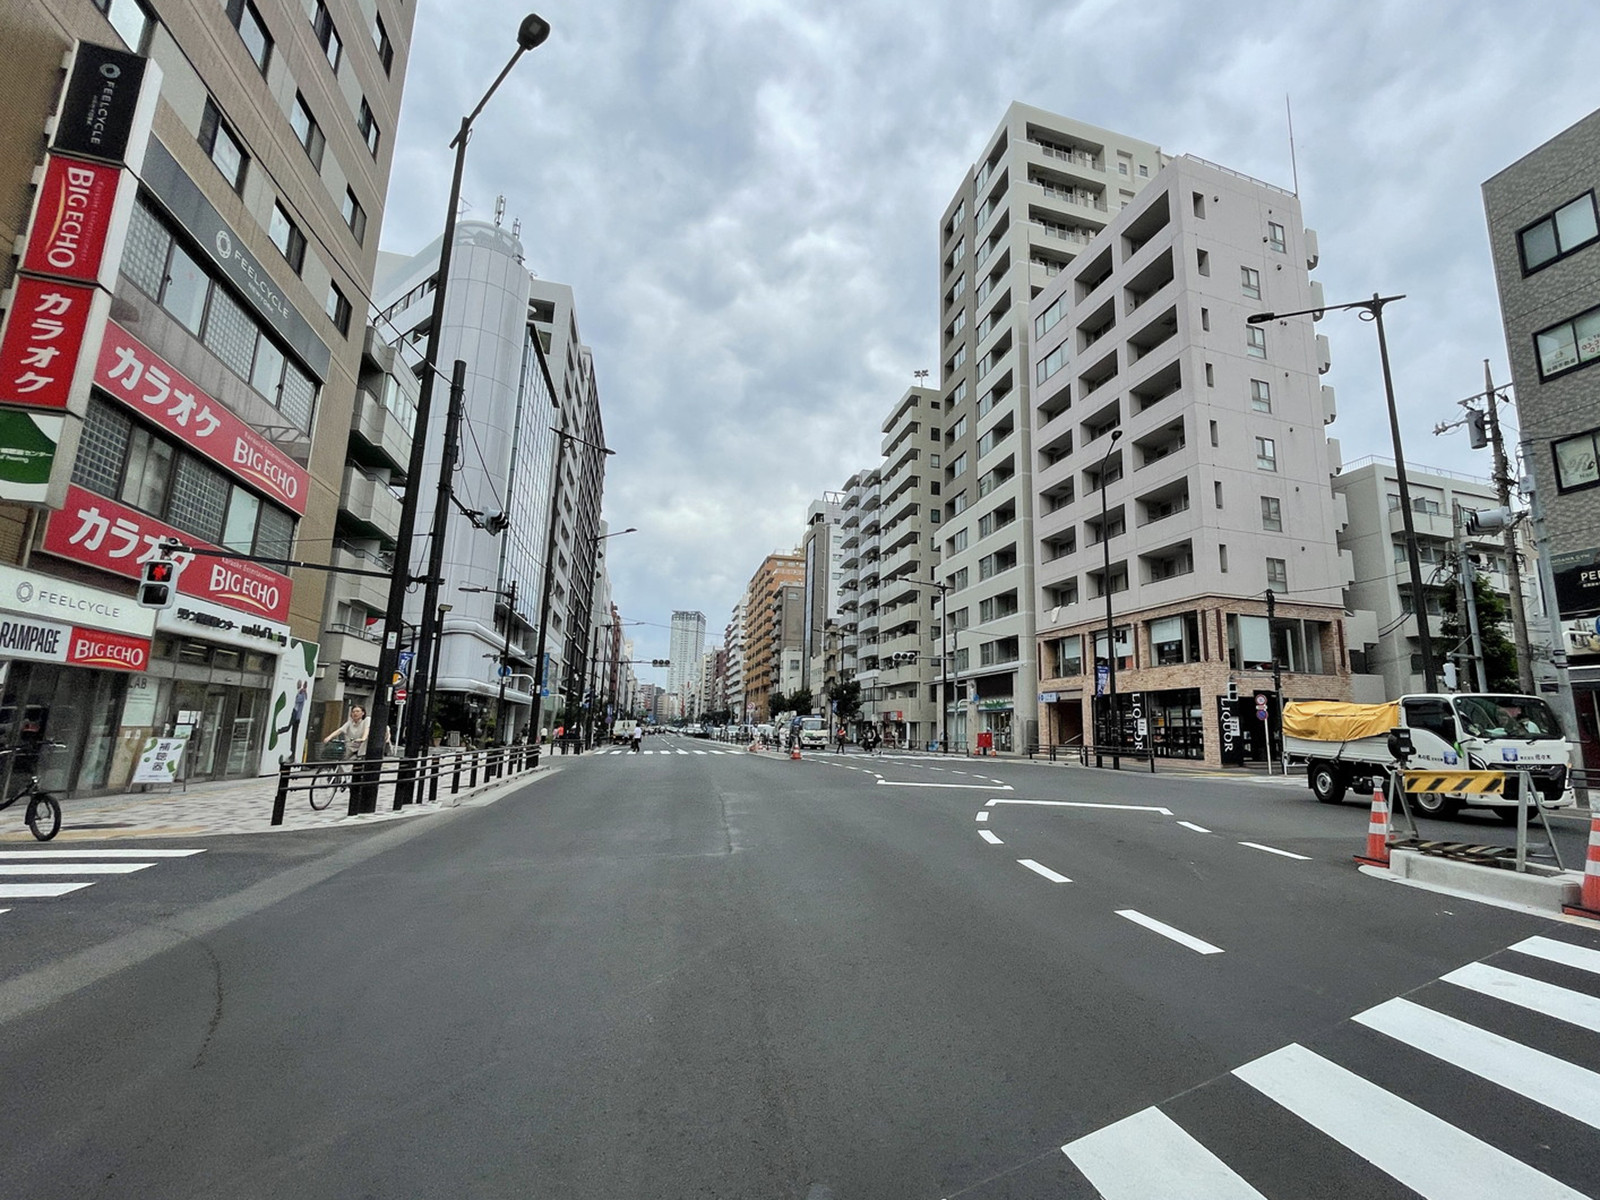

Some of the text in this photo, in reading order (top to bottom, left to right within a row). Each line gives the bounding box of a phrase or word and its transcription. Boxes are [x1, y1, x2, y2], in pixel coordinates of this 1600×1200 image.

[90, 81, 115, 144] FEELCYCLE
[47, 166, 95, 268] BIG ECHO
[234, 250, 290, 319] FEELCYCLE
[14, 293, 73, 393] カラオケ
[108, 346, 221, 437] カラオケ
[233, 436, 298, 499] BIG ECHO
[38, 591, 120, 617] FEELCYCLE
[209, 564, 279, 610] BIG ECHO
[0, 621, 61, 654] RAMPAGE
[74, 639, 144, 666] BIG ECHO
[1221, 697, 1234, 752] LIQUOR
